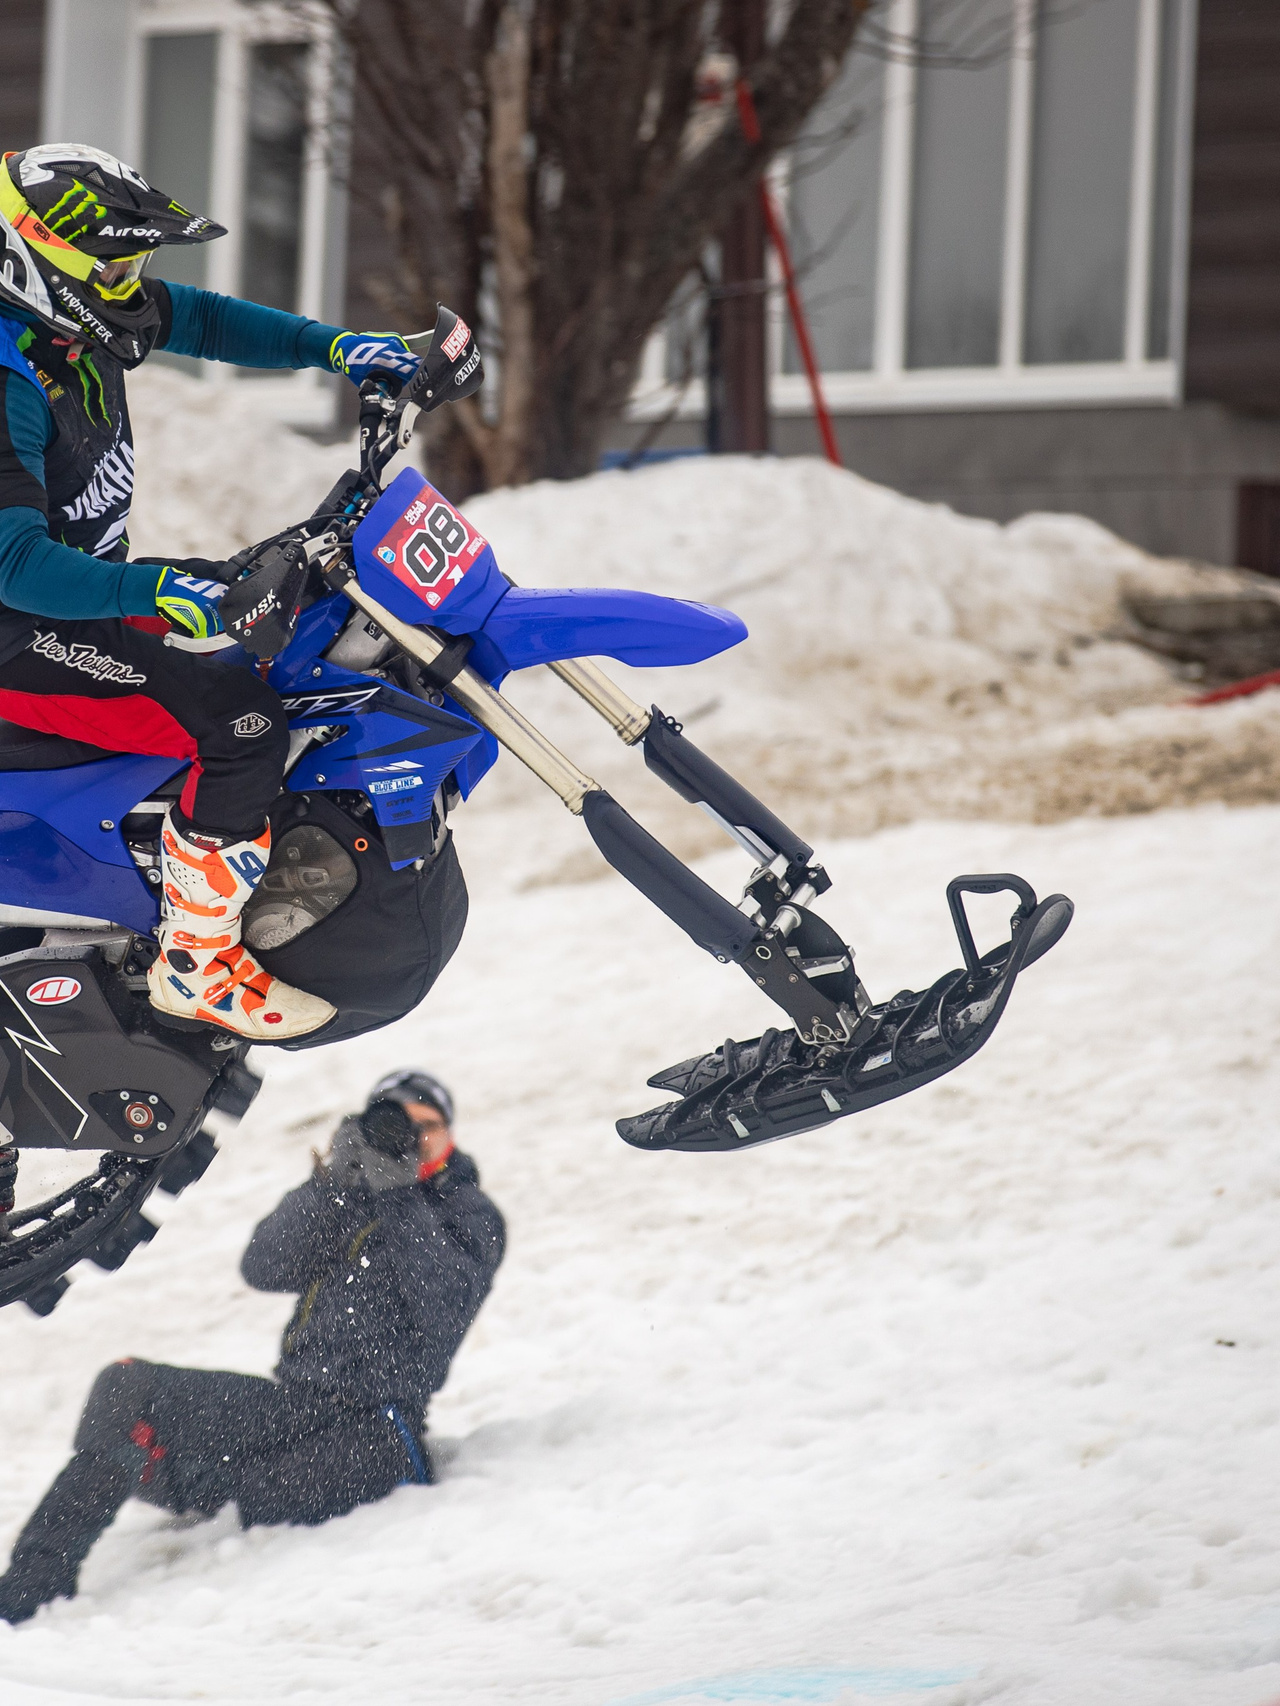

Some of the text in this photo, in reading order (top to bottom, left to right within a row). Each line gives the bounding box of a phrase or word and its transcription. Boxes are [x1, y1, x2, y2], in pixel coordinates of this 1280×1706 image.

[402, 502, 469, 588] 08
[232, 588, 277, 631] TUSK
[33, 632, 66, 661] Lee
[374, 778, 415, 792] BLUE LINE
